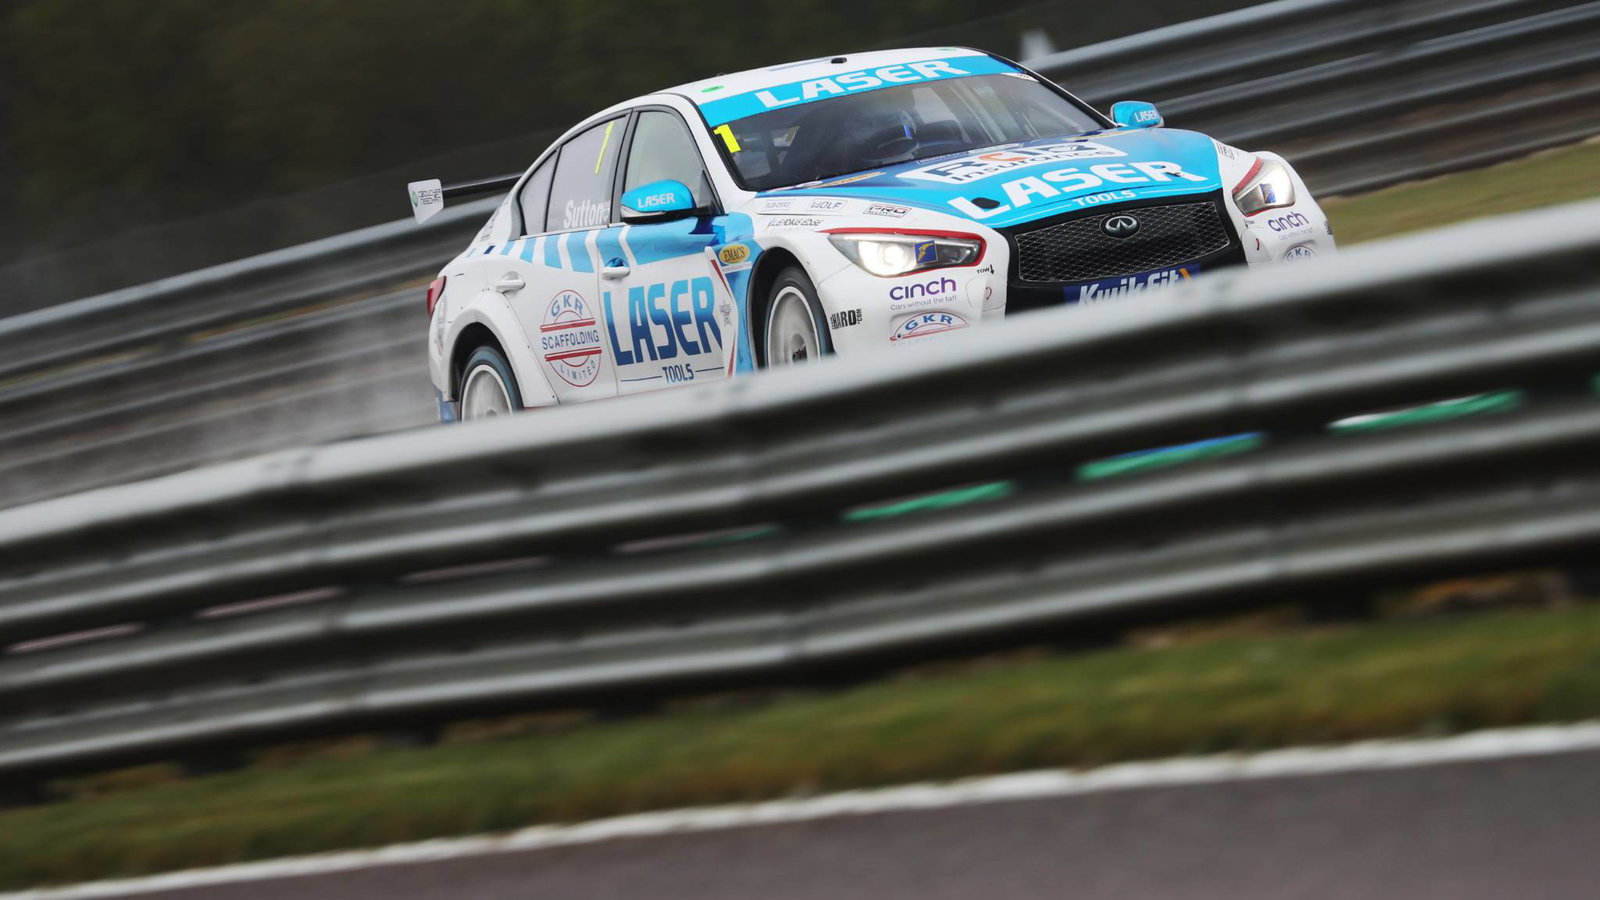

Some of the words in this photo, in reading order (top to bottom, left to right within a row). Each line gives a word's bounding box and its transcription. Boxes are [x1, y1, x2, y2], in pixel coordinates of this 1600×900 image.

[754, 60, 970, 109] LASER
[1133, 110, 1160, 122] LASER
[594, 121, 615, 174] 1
[713, 124, 741, 153] 1
[950, 151, 1115, 181] Insurance
[637, 192, 676, 208] LASER
[947, 160, 1209, 220] LASER
[1076, 189, 1136, 207] TOOLS
[563, 199, 604, 229] Sutton
[810, 201, 842, 209] WOLF
[1268, 211, 1309, 232] cinch
[722, 246, 746, 261] EMACS
[889, 277, 957, 300] cinch
[551, 295, 584, 318] GKR
[890, 303, 906, 311] Cars
[907, 299, 931, 308] without
[603, 276, 722, 366] LASER
[905, 314, 953, 331] GKR
[541, 330, 600, 350] SCAFFOLDING
[560, 359, 596, 380] LIMITED
[661, 364, 695, 383] TOOLS
